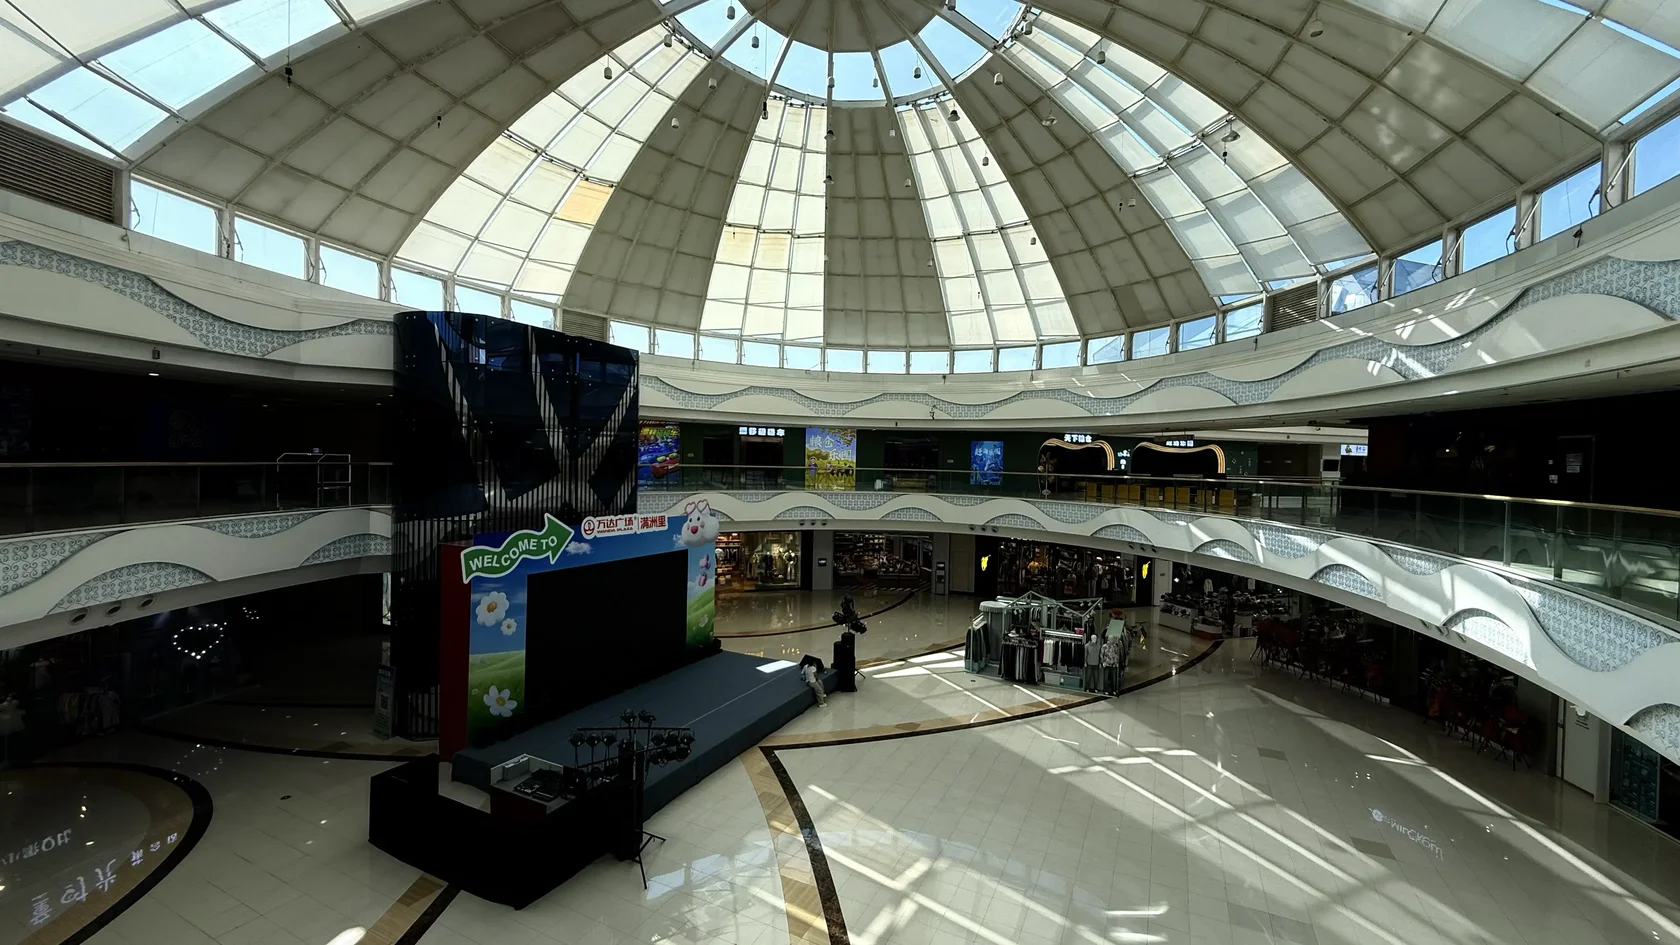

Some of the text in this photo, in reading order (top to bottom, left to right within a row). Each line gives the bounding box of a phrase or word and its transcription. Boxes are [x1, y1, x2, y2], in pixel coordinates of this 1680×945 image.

[596, 515, 667, 530] 万达广场 满洲里
[469, 535, 558, 571] WELCOME TO
